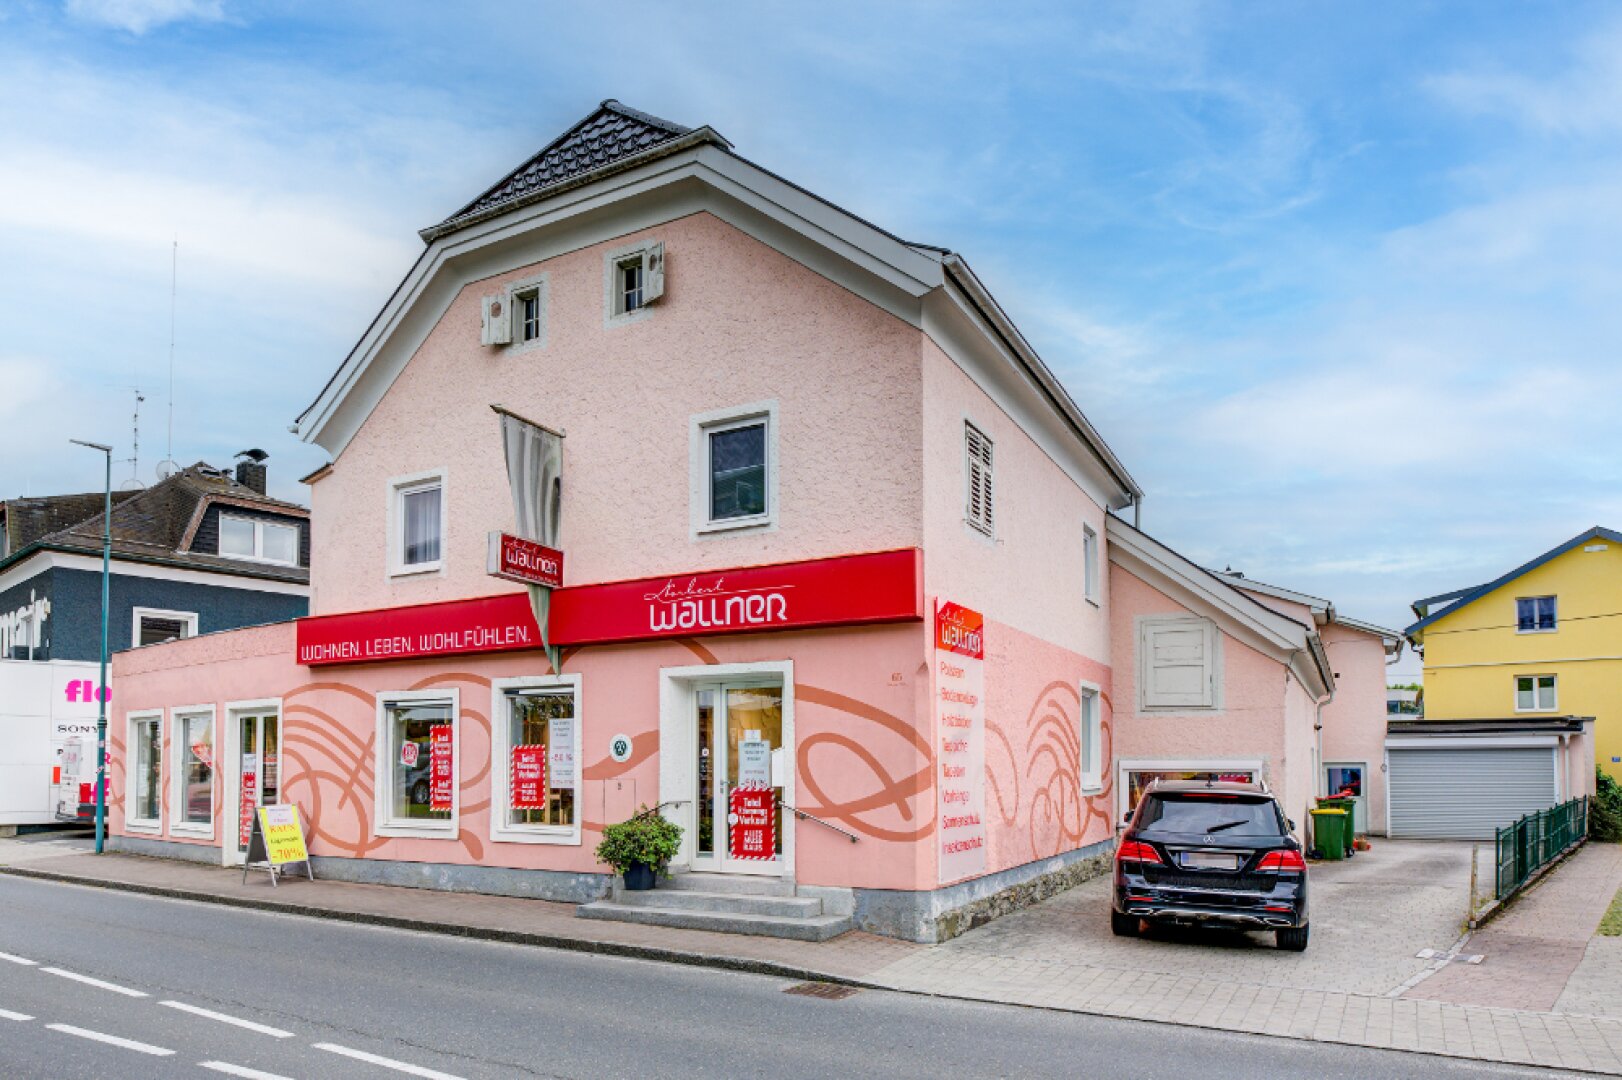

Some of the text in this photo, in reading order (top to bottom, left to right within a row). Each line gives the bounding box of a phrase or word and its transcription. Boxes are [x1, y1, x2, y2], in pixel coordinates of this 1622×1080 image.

[301, 625, 532, 661] WOHNEN. LEBEN. WOHLFÜHLEN.
